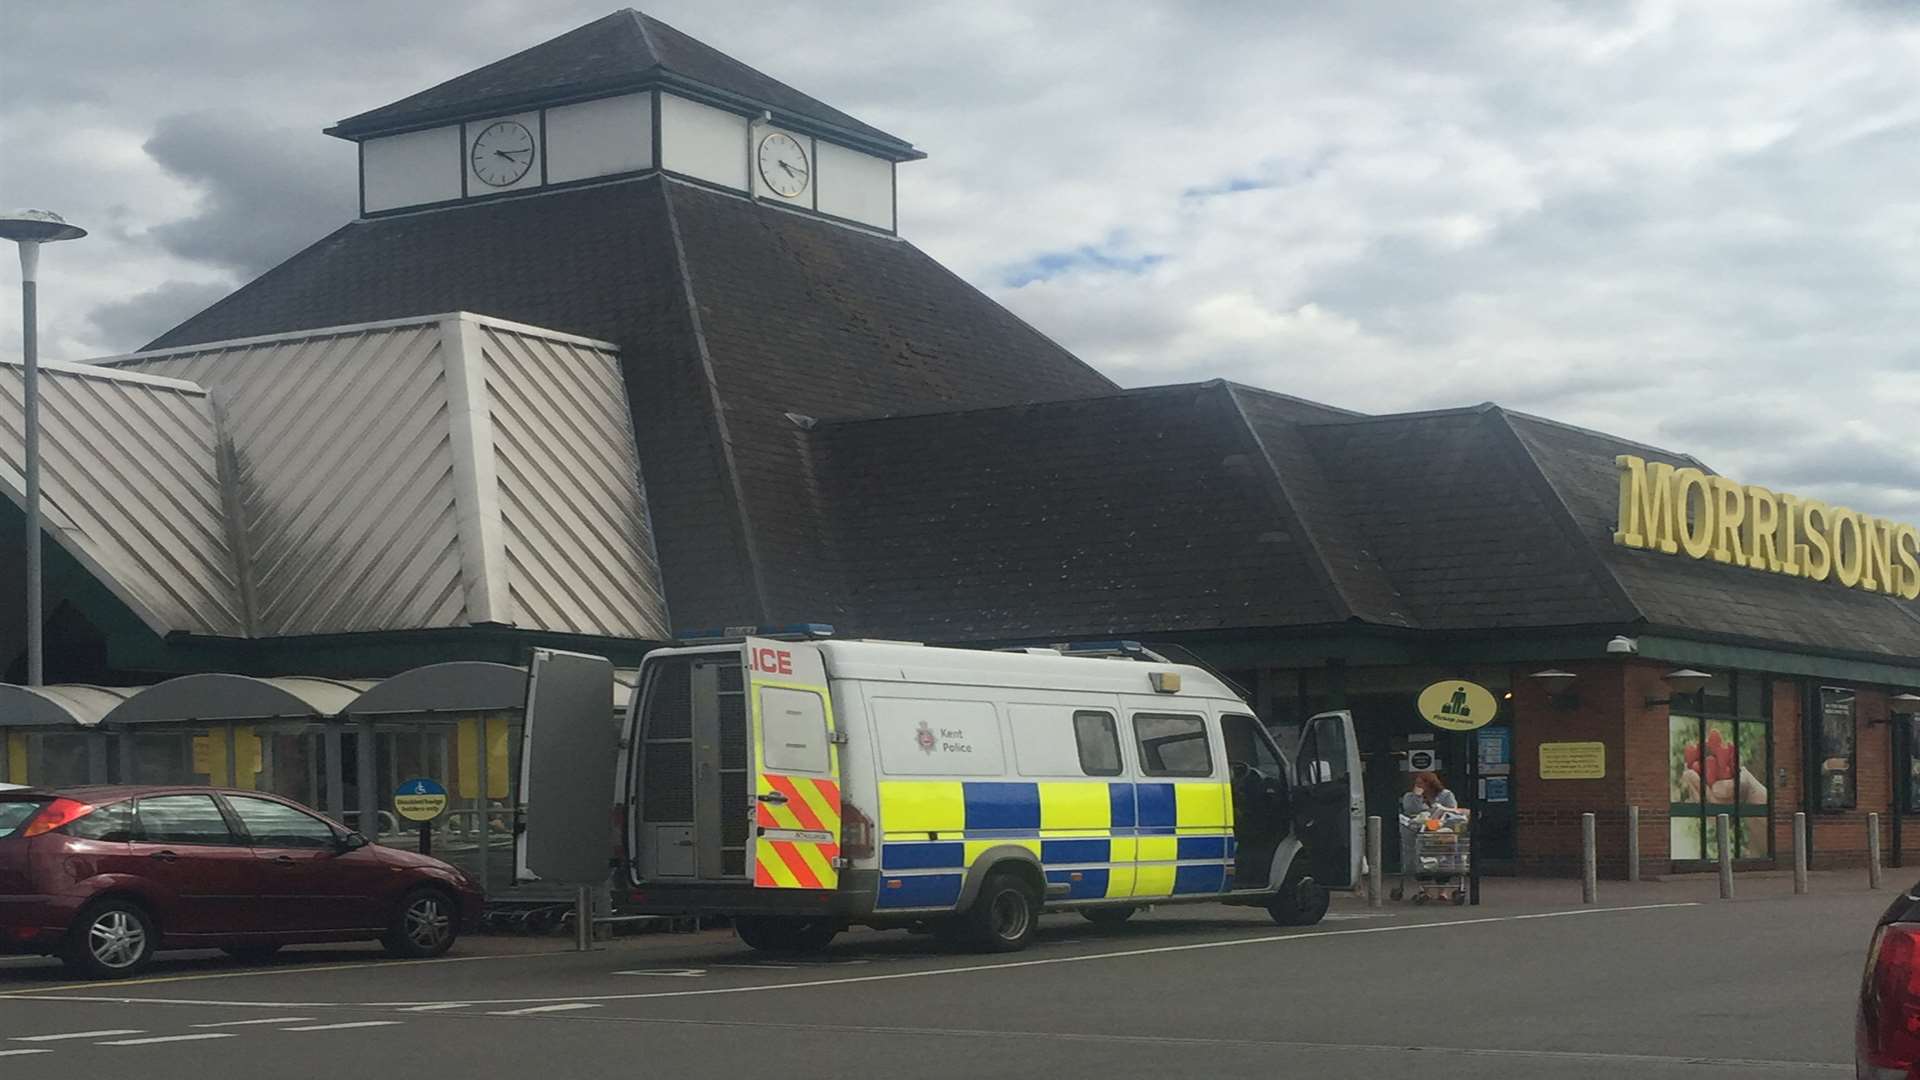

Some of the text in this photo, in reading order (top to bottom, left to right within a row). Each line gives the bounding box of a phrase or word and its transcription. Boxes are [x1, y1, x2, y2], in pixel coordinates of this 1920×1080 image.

[1613, 454, 1920, 600] MORRISONS
[749, 648, 792, 675] ICE
[940, 728, 964, 739] Kent
[943, 742, 973, 753] Police
